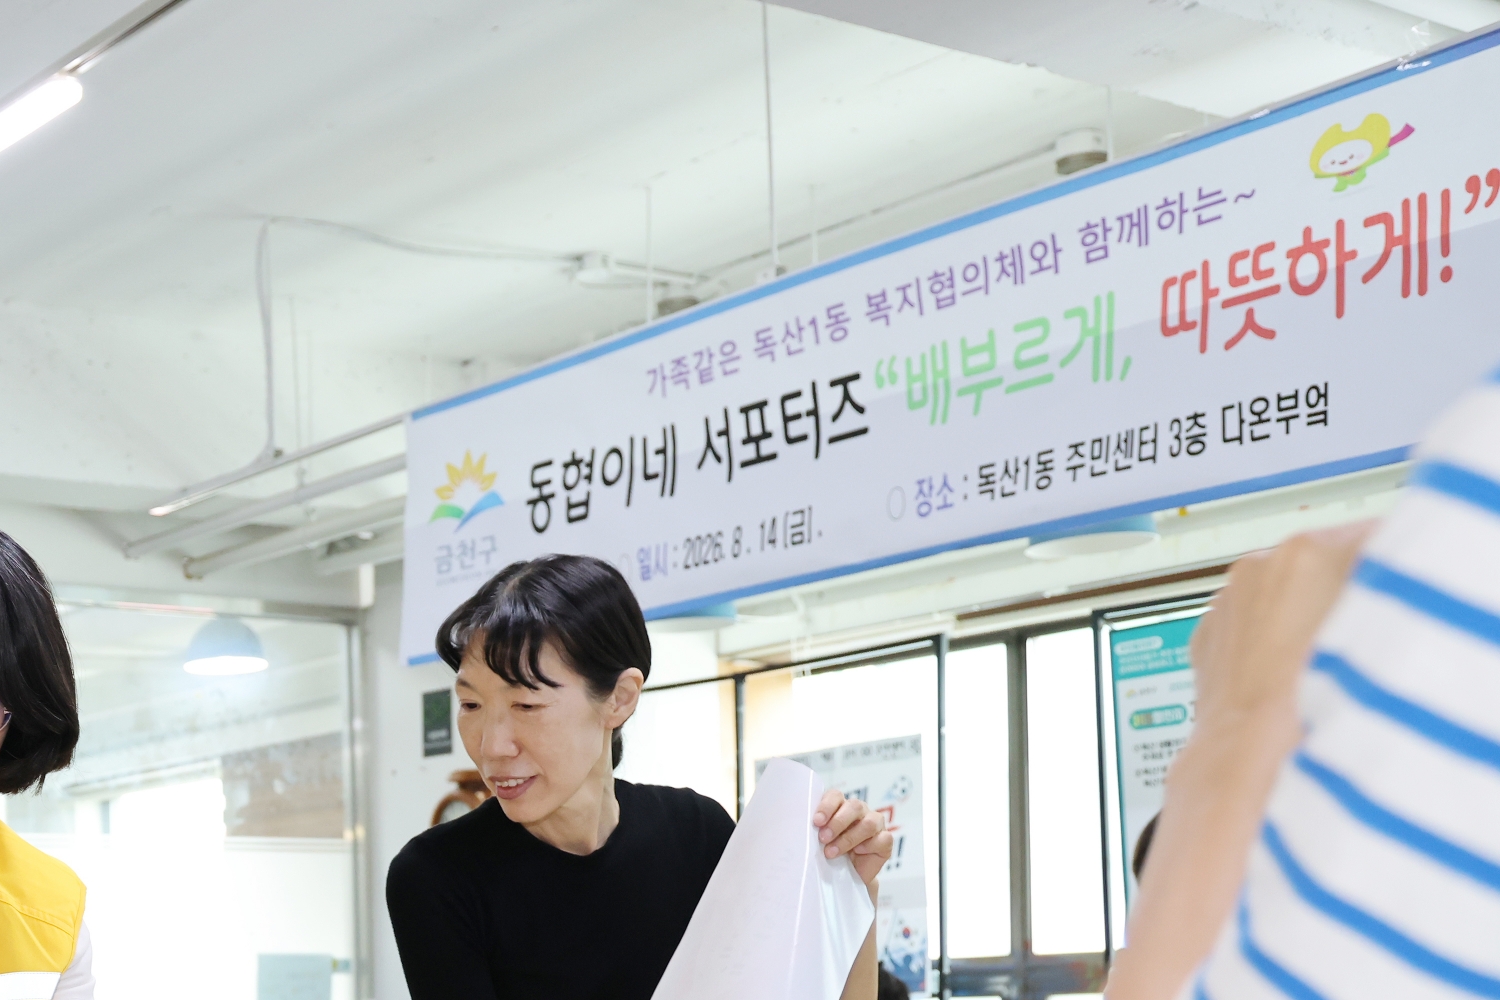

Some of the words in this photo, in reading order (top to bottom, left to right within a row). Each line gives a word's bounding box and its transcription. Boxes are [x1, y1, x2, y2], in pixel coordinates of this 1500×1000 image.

[646, 338, 741, 397] 가족같은
[753, 301, 851, 365] 독산1동
[864, 233, 1064, 327] 복지협의체와
[526, 423, 678, 534] 동협이네
[696, 372, 870, 484] 서포터즈
[977, 447, 1055, 501] 독산1동
[1065, 421, 1159, 482] 주민센터
[1168, 411, 1209, 460] 3층
[1221, 381, 1330, 448] 다온부엌
[435, 535, 497, 574] 금천구
